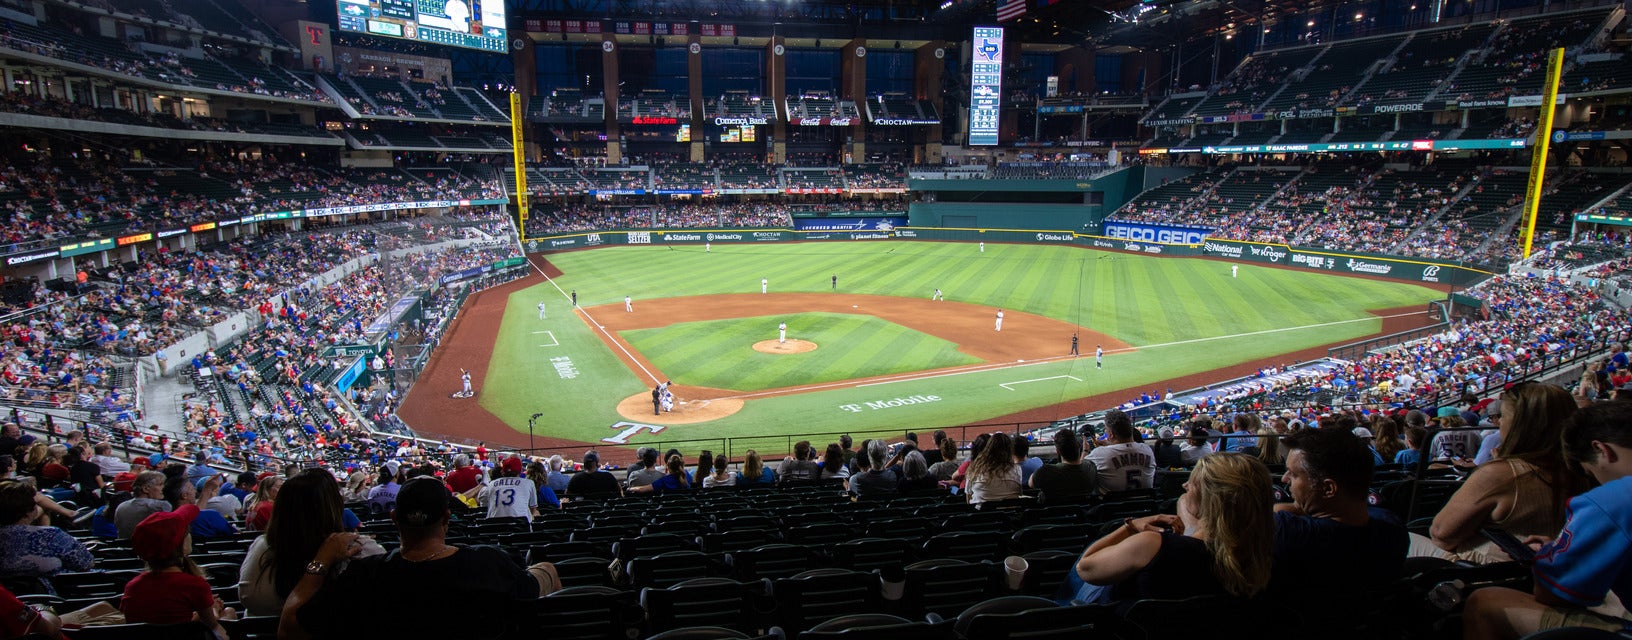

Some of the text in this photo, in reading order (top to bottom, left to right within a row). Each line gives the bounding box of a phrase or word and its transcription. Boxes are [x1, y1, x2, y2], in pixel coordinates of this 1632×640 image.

[1374, 103, 1424, 113] POWERADE
[749, 117, 767, 125] Bank
[878, 118, 911, 126] CHOCTAW
[588, 233, 601, 242] UTA
[1105, 225, 1155, 243] GEICO
[628, 236, 651, 244] SELTZER
[1212, 243, 1243, 254] National
[1261, 246, 1286, 262] Kroger
[1307, 256, 1324, 265] BITE
[1358, 261, 1392, 272] Germania
[863, 394, 943, 410] Mobile
[1442, 443, 1467, 458] 53
[493, 479, 521, 488] GALLO
[495, 488, 516, 508] 13
